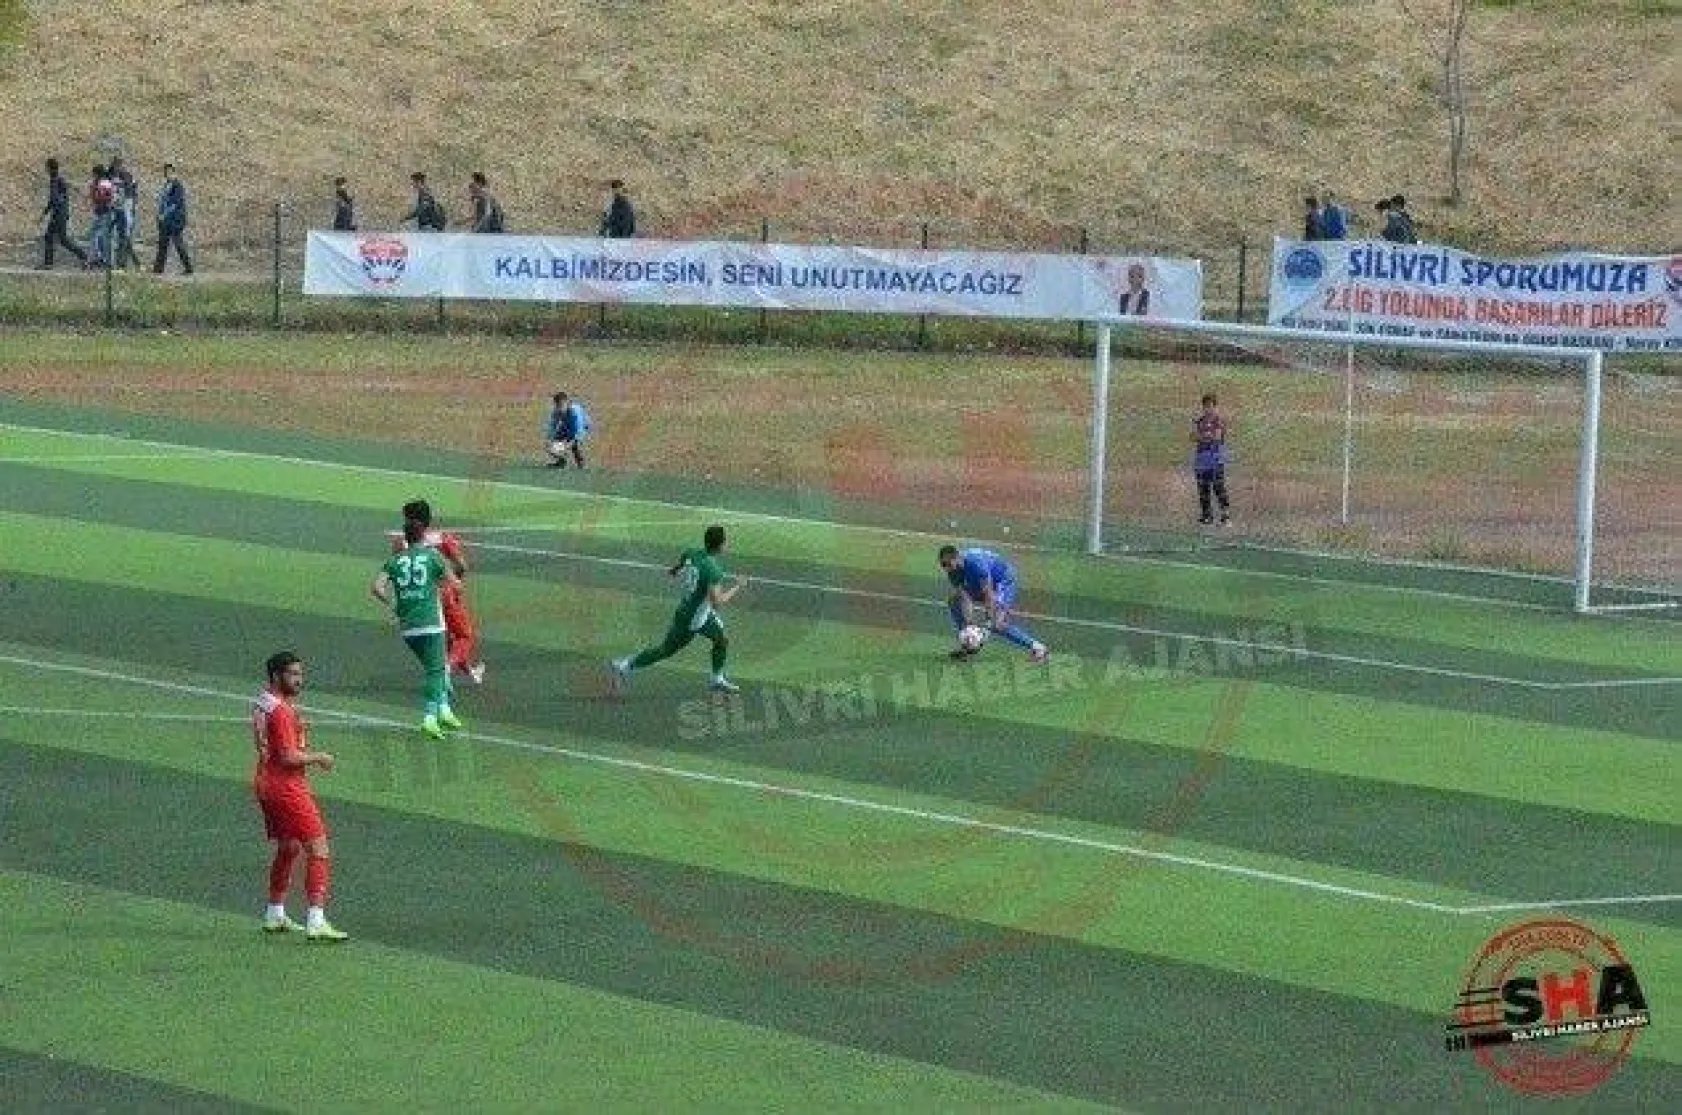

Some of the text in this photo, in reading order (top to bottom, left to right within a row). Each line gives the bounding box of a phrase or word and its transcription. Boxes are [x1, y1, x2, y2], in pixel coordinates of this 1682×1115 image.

[722, 261, 783, 287] SENİ
[791, 266, 1024, 295] UNUTMAYACAĞIZ
[1348, 244, 1649, 293] SİLİVRİ SPORUMUZA
[396, 555, 428, 587] 35
